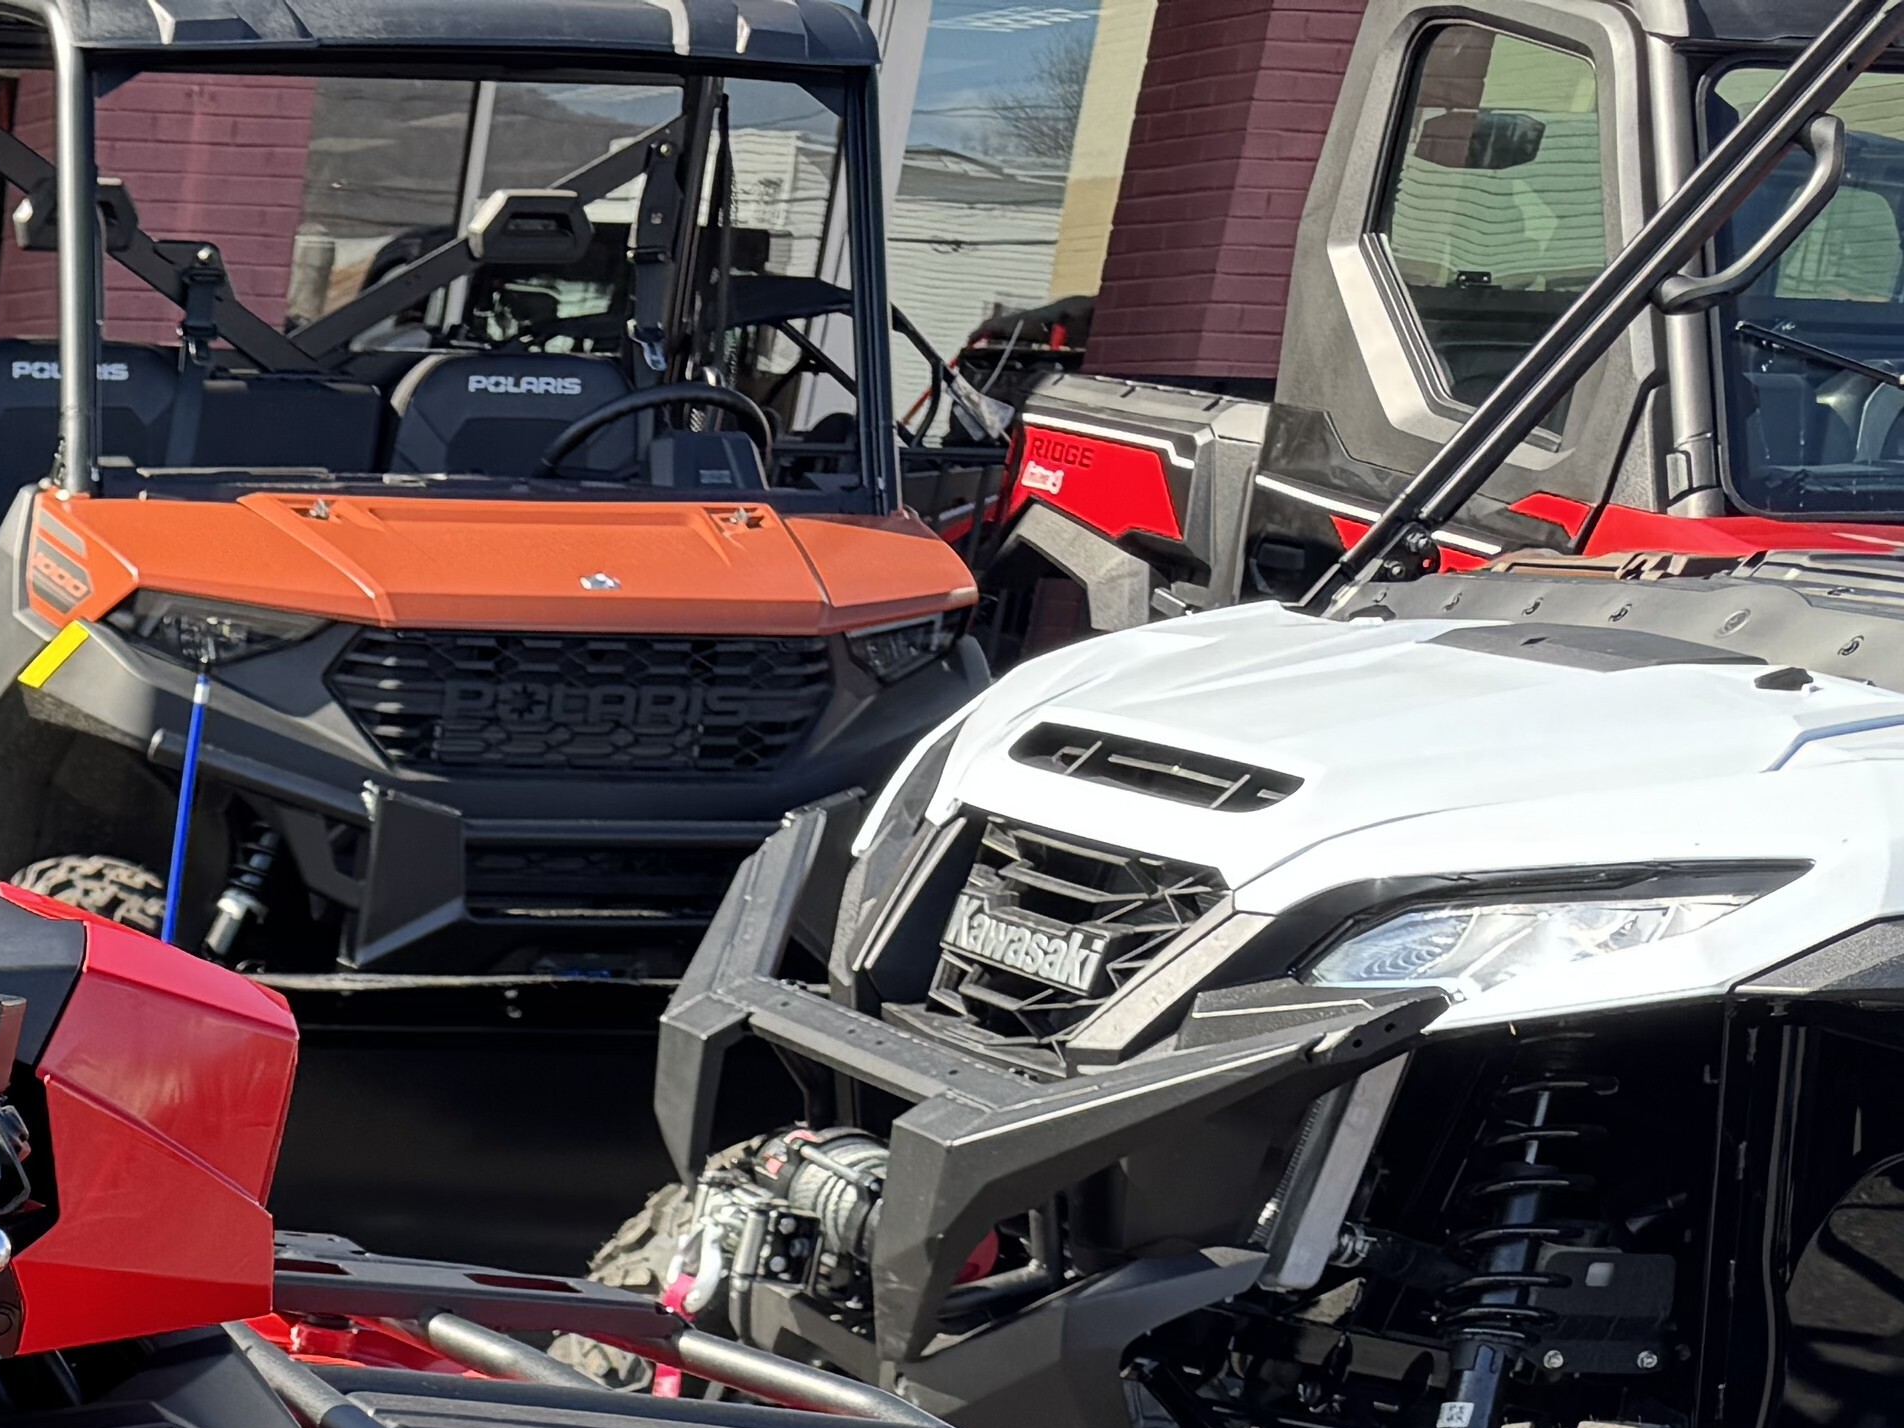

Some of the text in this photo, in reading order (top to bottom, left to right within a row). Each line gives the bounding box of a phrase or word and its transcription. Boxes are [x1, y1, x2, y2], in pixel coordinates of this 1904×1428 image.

[11, 360, 130, 381] POLIS
[467, 374, 582, 395] POLARIS
[1032, 437, 1095, 469] RIDGE
[444, 682, 750, 733] POLARIS
[943, 894, 1107, 991] Kawasaki
